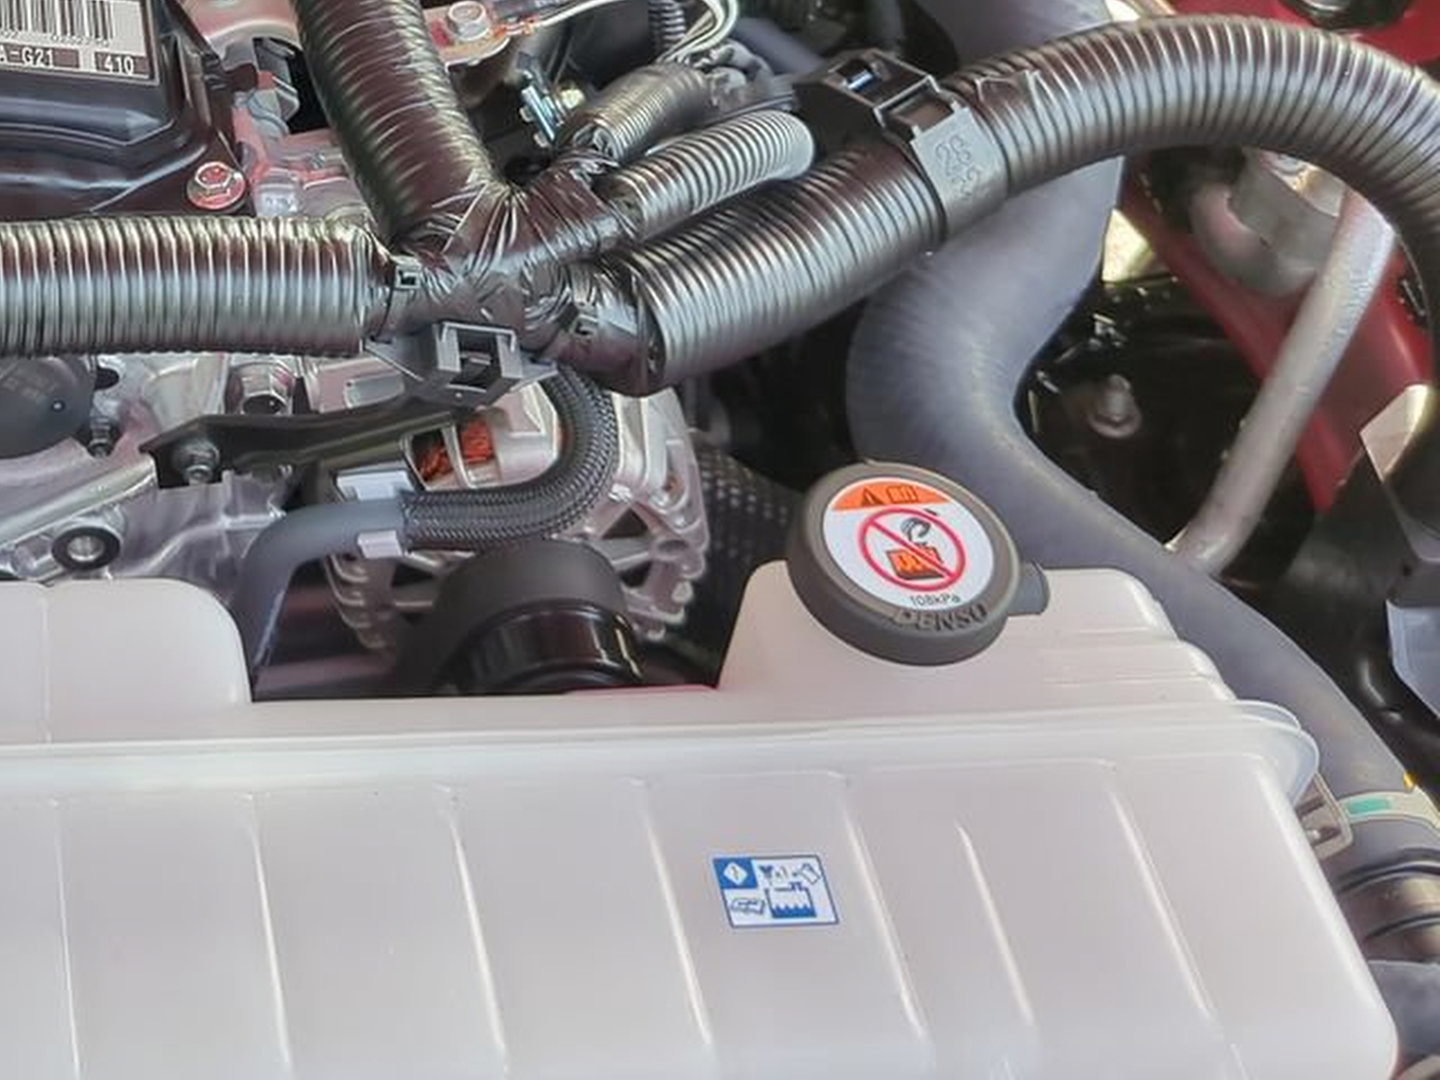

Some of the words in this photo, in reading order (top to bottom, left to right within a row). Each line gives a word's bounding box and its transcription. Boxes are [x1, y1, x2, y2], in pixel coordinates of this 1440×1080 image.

[104, 55, 135, 74] 410
[910, 593, 961, 606] 108kPa
[893, 603, 988, 631] DENSO
